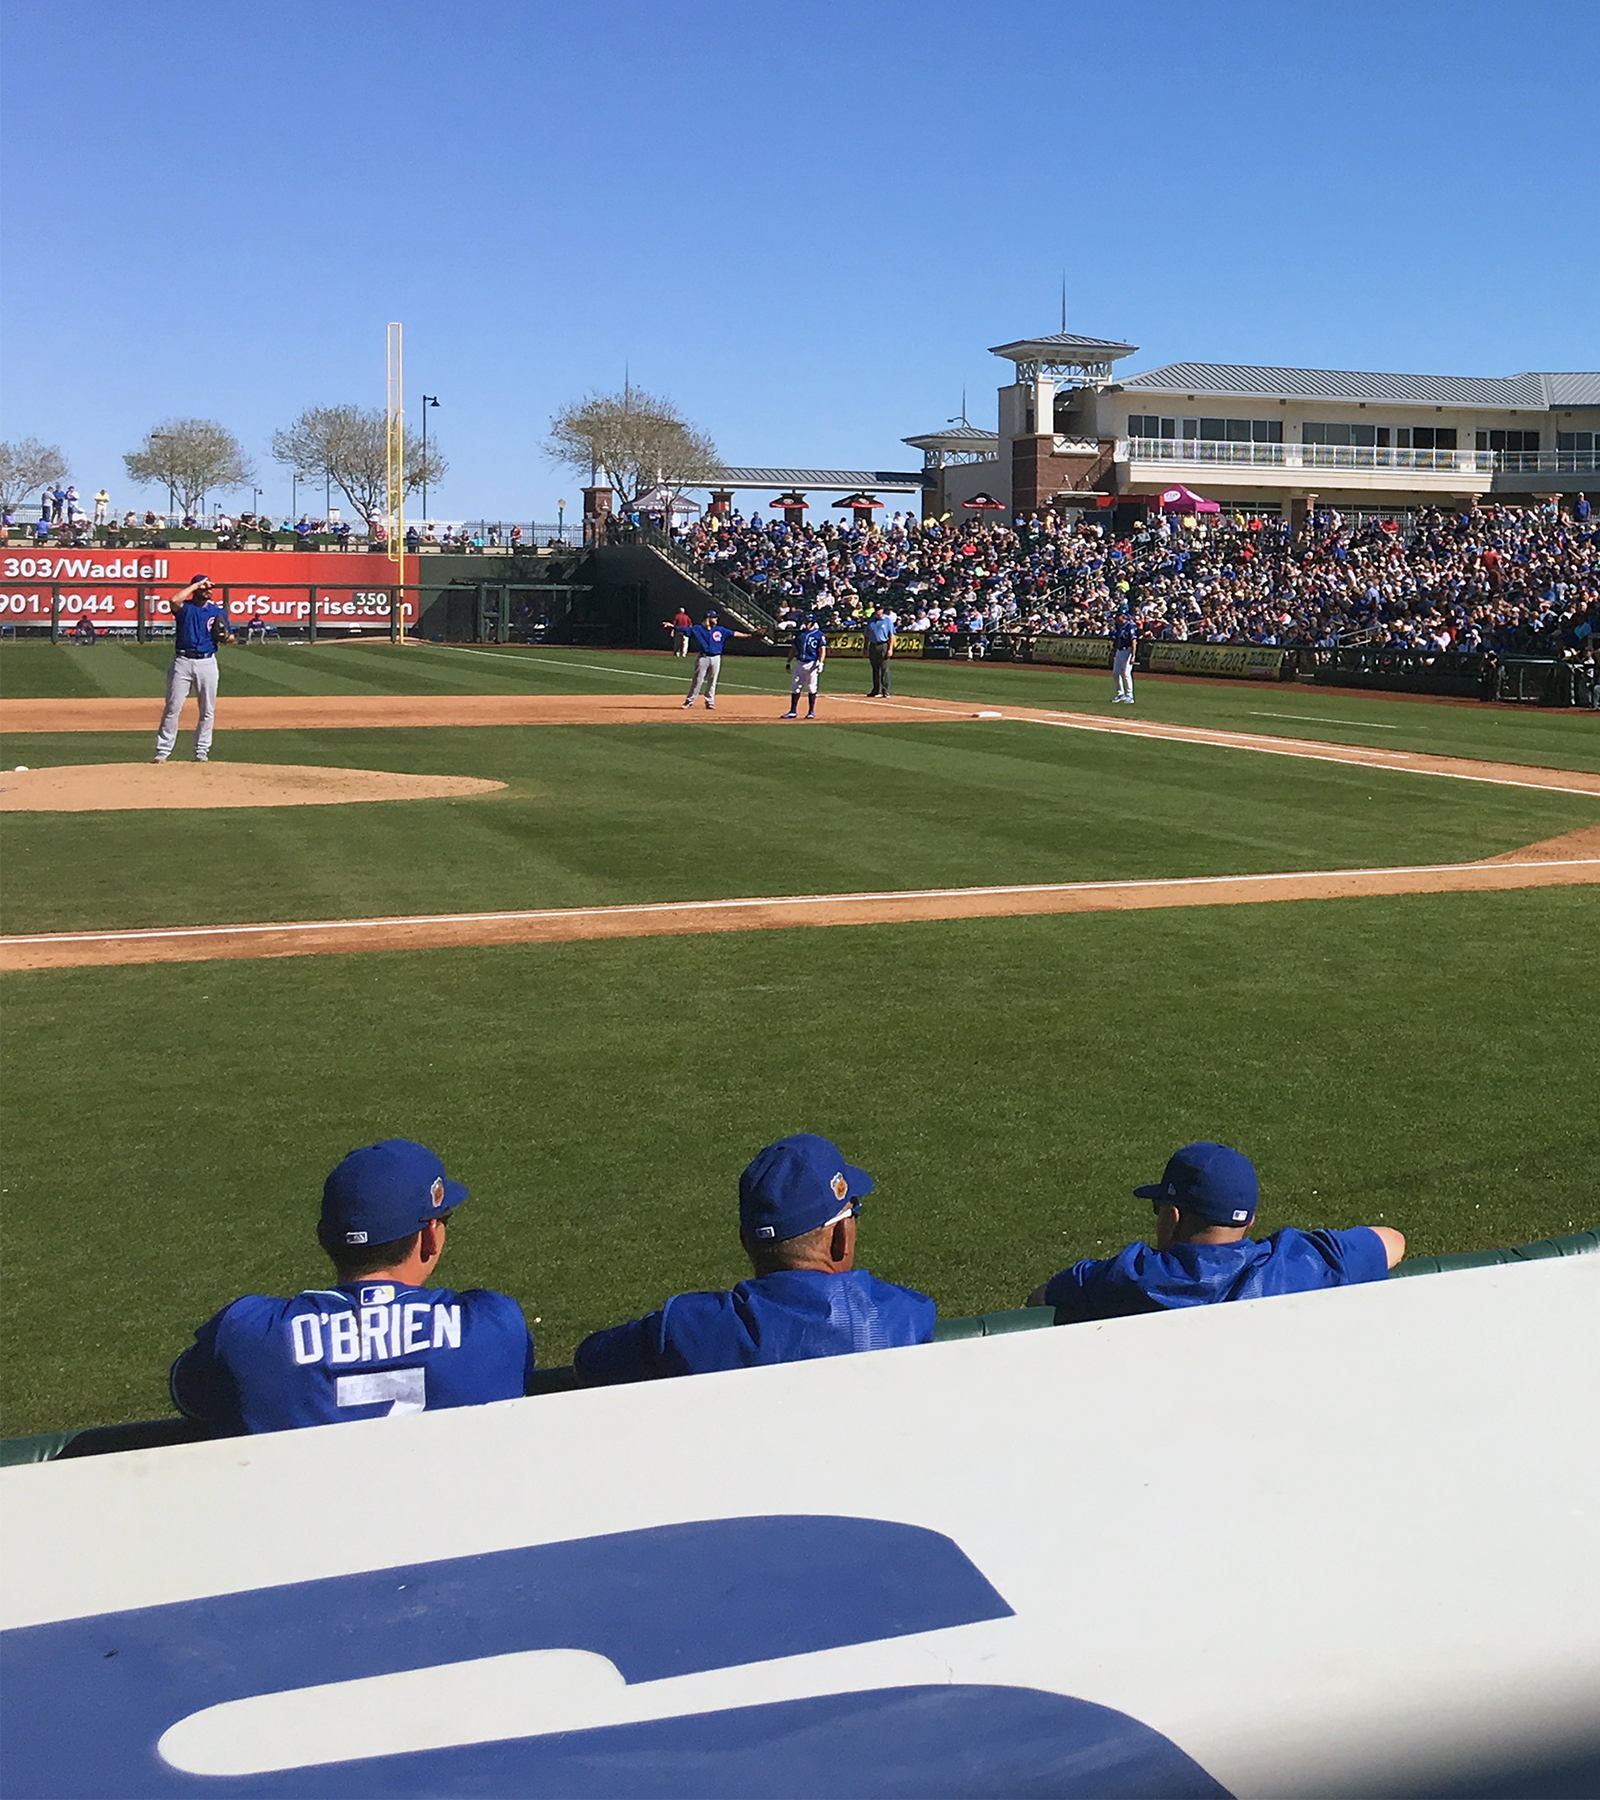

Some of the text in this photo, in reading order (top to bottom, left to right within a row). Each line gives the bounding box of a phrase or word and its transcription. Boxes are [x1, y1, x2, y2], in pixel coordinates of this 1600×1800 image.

[4, 557, 168, 579] 303/Waddell
[356, 593, 387, 607] 350
[291, 1302, 462, 1365] O'BRIEN
